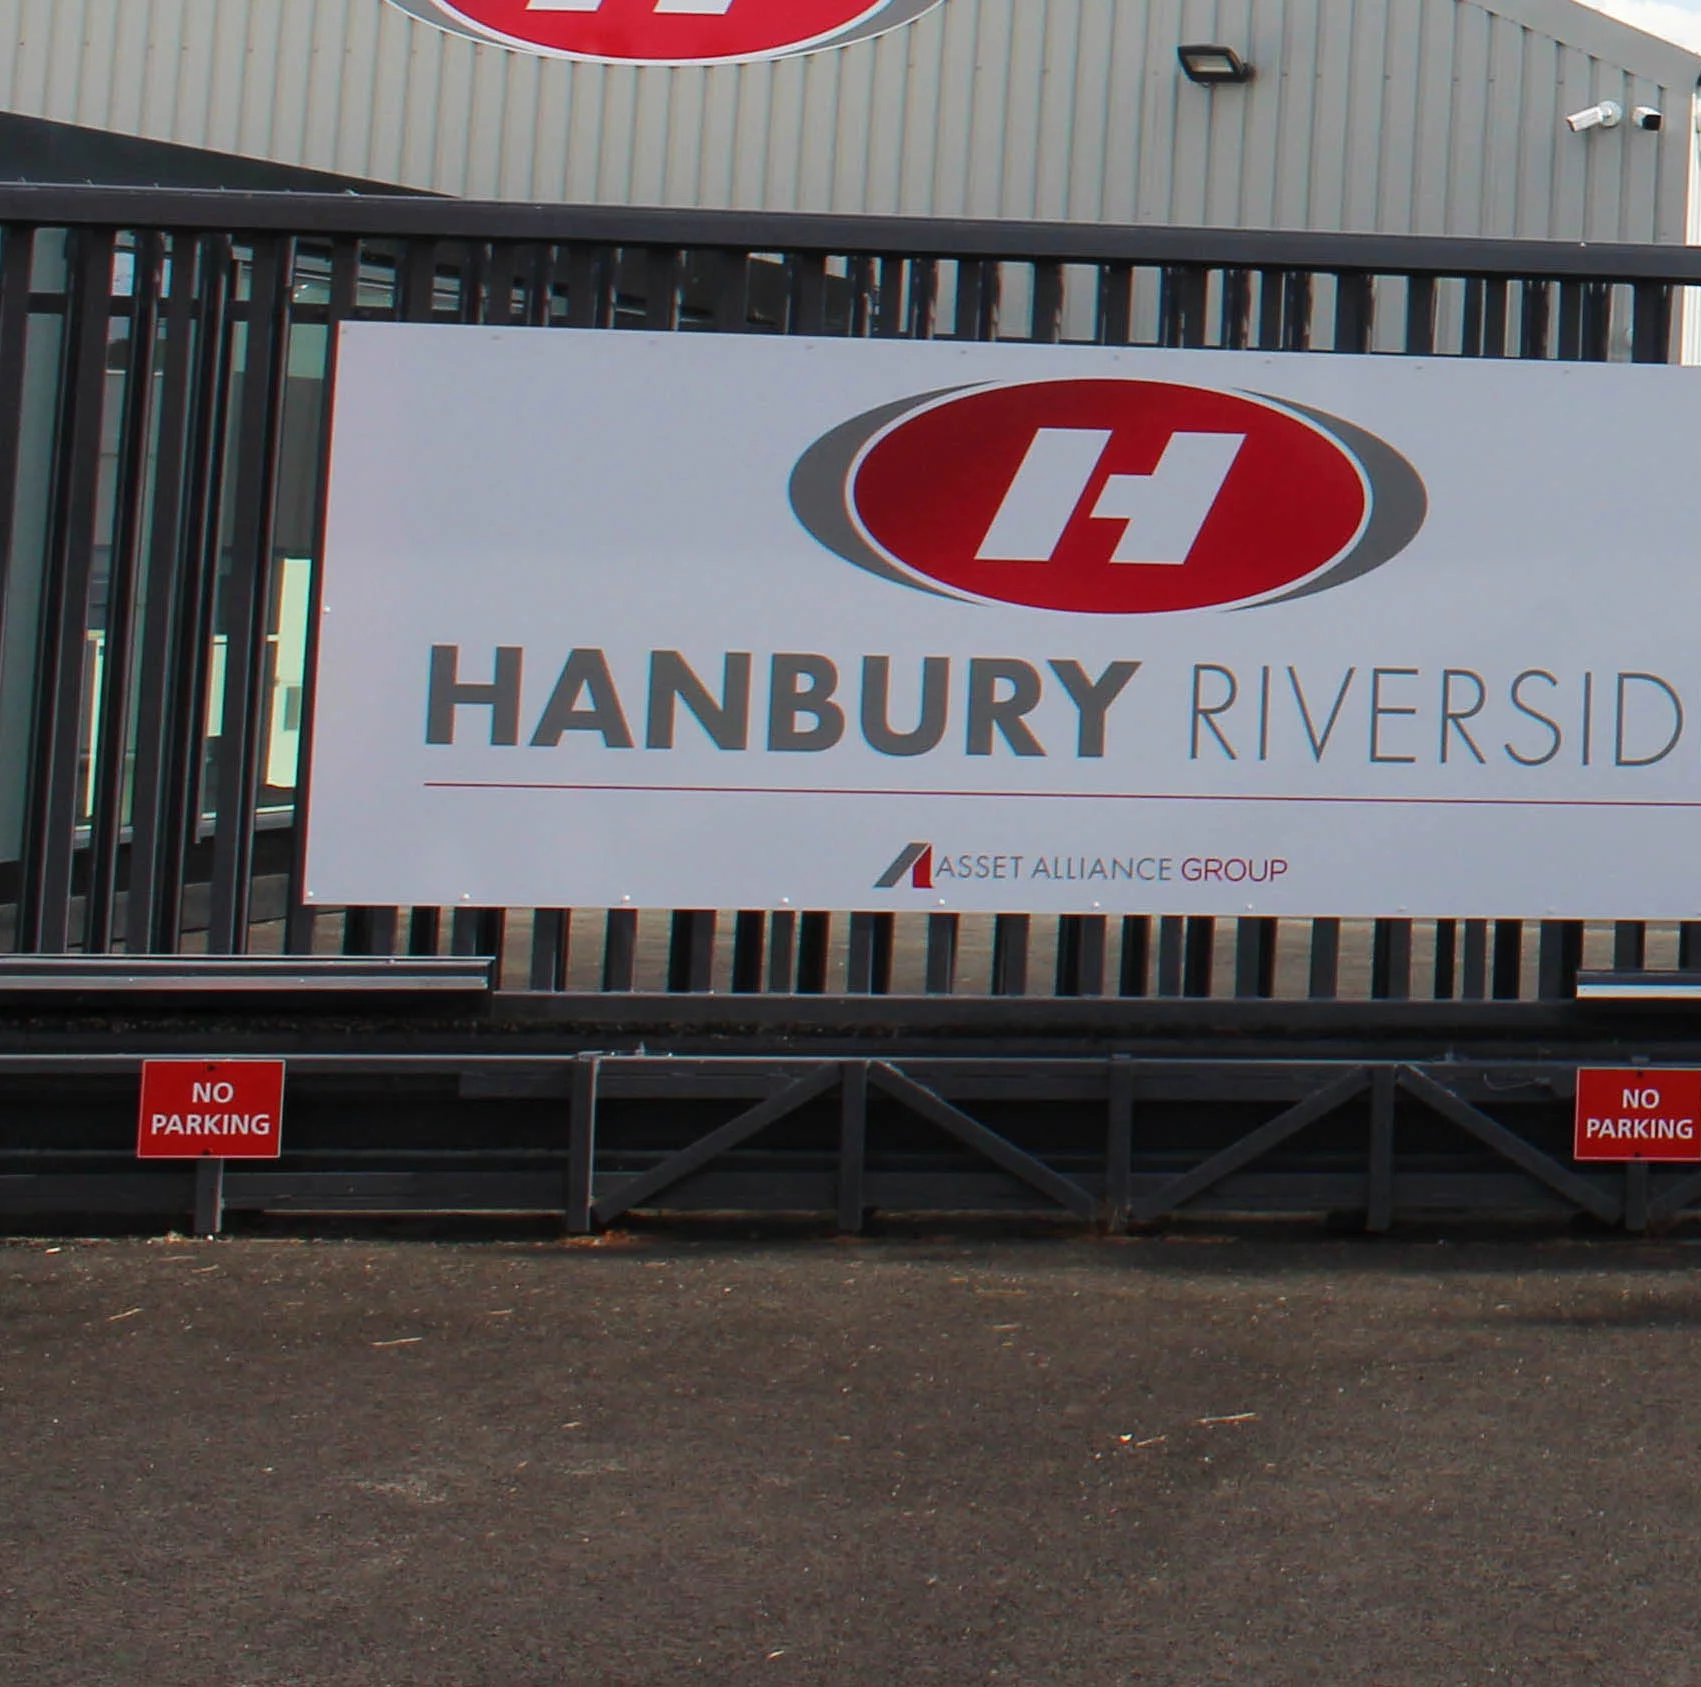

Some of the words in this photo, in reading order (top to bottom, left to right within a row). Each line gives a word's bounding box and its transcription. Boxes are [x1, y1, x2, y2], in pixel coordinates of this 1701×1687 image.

[424, 644, 1143, 758] HANBURY
[935, 854, 1024, 880] ASSET
[1031, 856, 1173, 882] ALLIANCE
[1180, 857, 1289, 883] GROUP
[191, 1081, 235, 1104] NO
[1622, 1088, 1660, 1109] NO
[151, 1113, 271, 1136] PARKING
[1586, 1118, 1694, 1140] PARKING
